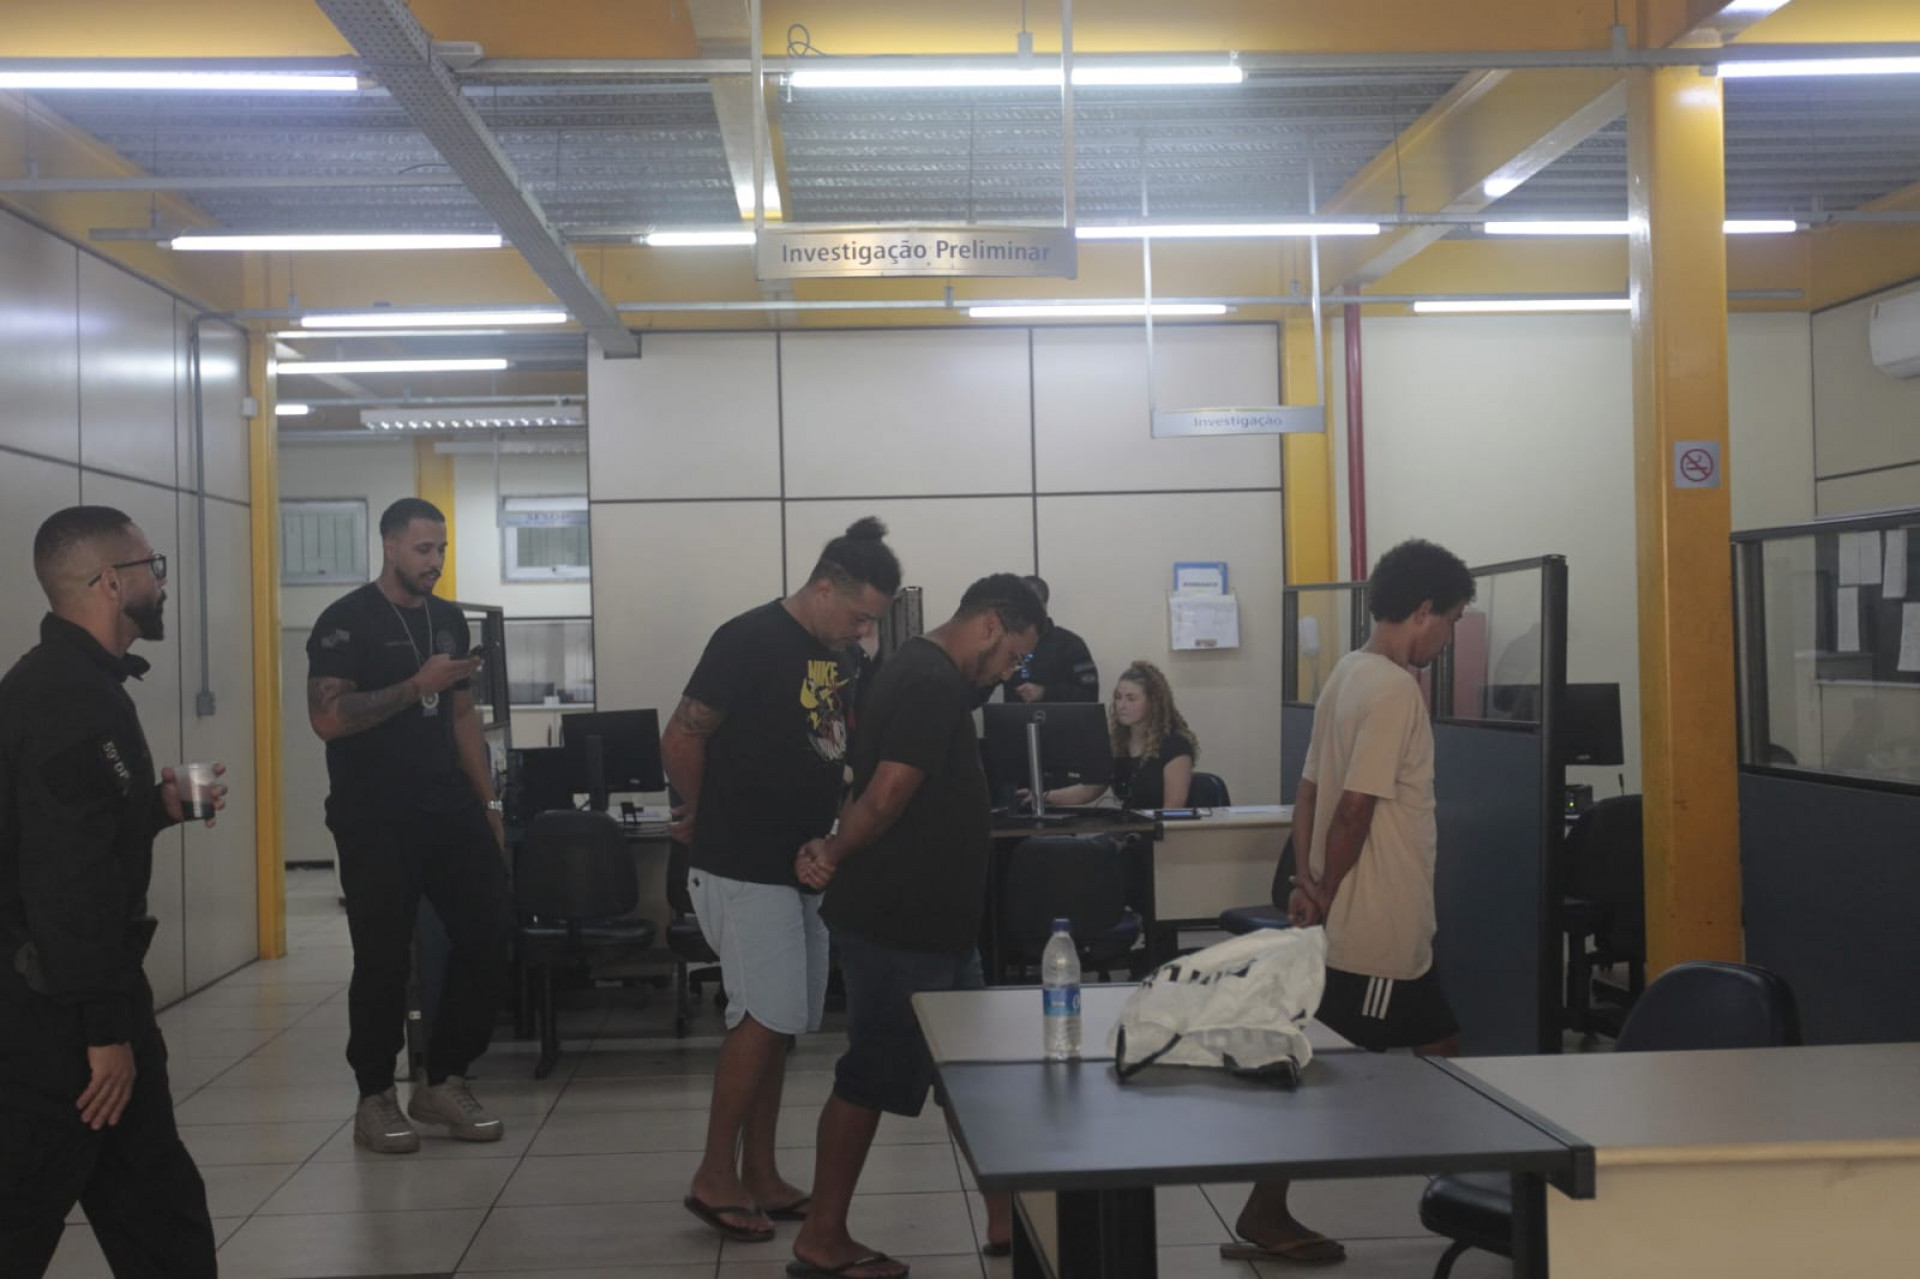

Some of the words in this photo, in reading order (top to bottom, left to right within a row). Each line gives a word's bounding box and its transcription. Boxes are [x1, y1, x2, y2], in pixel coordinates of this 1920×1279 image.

[782, 240, 927, 265] Investigação
[935, 239, 1049, 262] Preliminar
[1194, 415, 1283, 428] Investigação
[808, 660, 838, 687] NIKE
